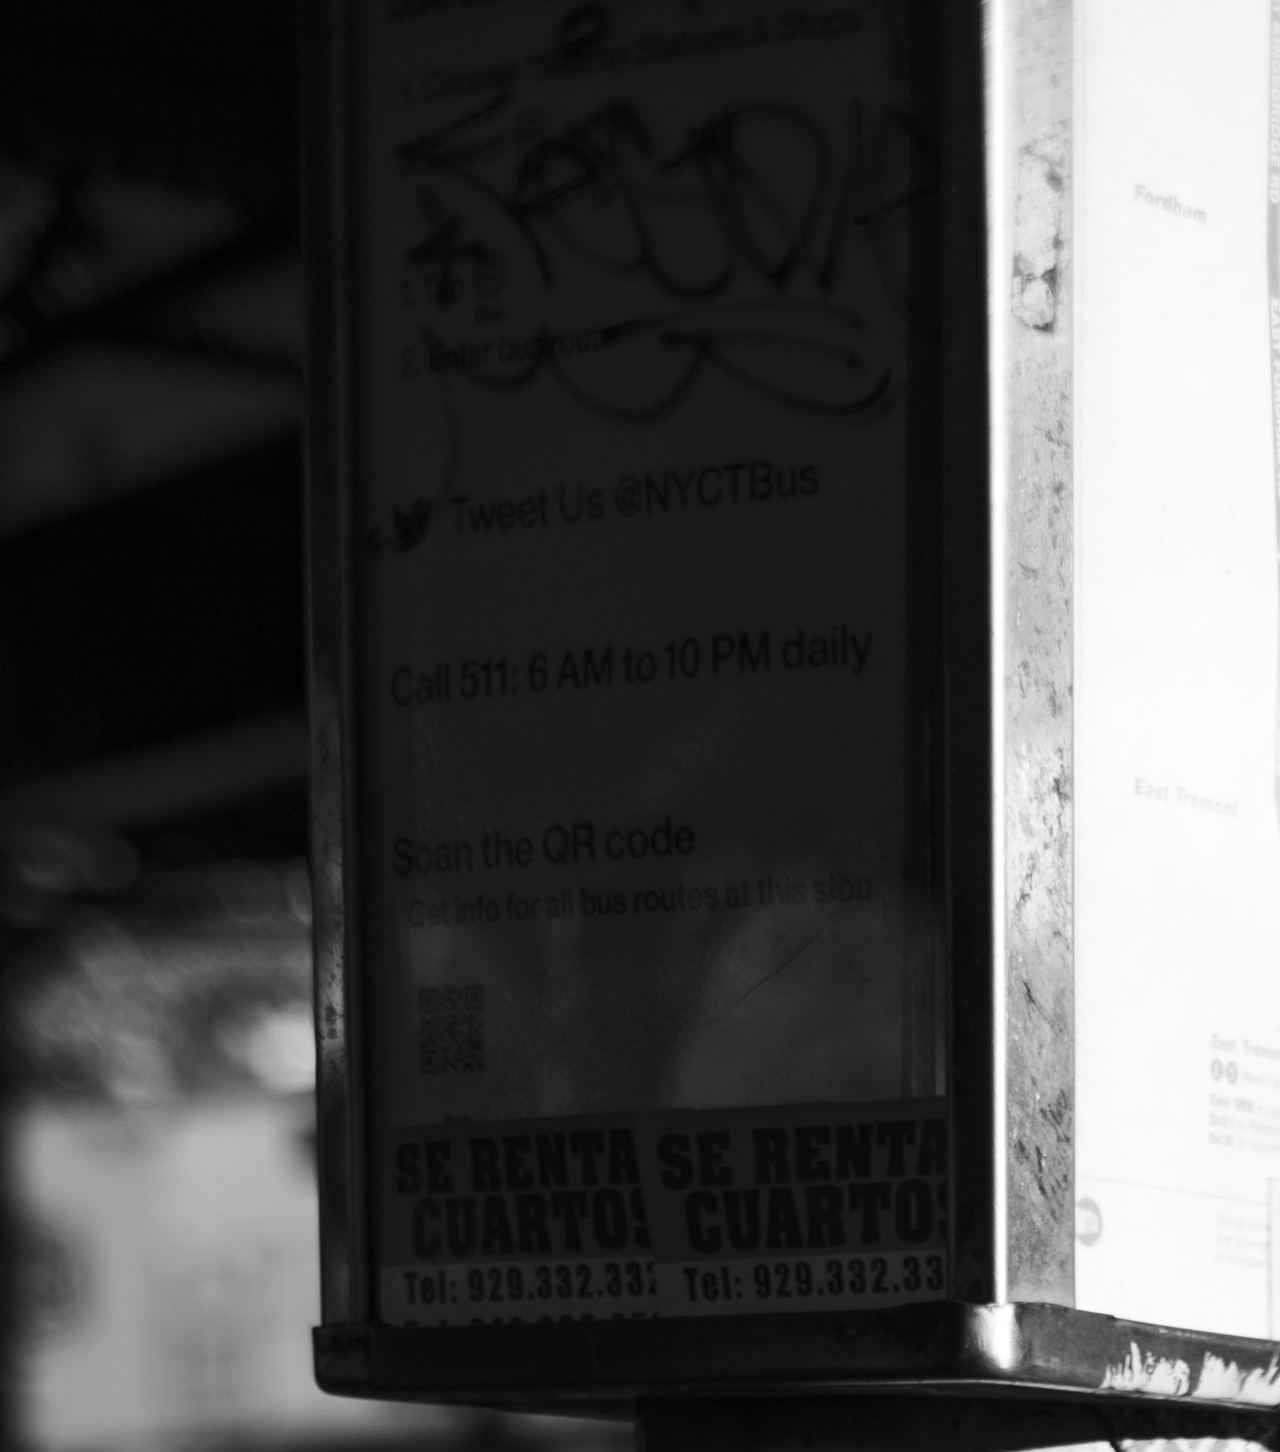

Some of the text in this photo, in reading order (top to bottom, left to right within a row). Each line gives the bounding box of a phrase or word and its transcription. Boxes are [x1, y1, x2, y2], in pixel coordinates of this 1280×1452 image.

[1133, 182, 1209, 226] Fordham
[449, 460, 821, 536] Tweet Us @NYCTBus
[391, 624, 873, 707] Call 511: 6 AM to 10 PM daily
[1133, 775, 1170, 802] East
[392, 817, 697, 877] Scan the QR code
[407, 896, 449, 928] Get
[455, 892, 502, 925] info
[504, 890, 540, 922] for
[543, 888, 575, 919] all
[578, 886, 627, 918] bus
[632, 882, 720, 915] routes
[723, 878, 752, 910] at
[755, 874, 808, 907] this
[395, 1128, 641, 1198] SE RENTA
[656, 1116, 948, 1191] SE RENTA
[404, 1268, 459, 1305] Tel:
[682, 1265, 743, 1302] Tel:
